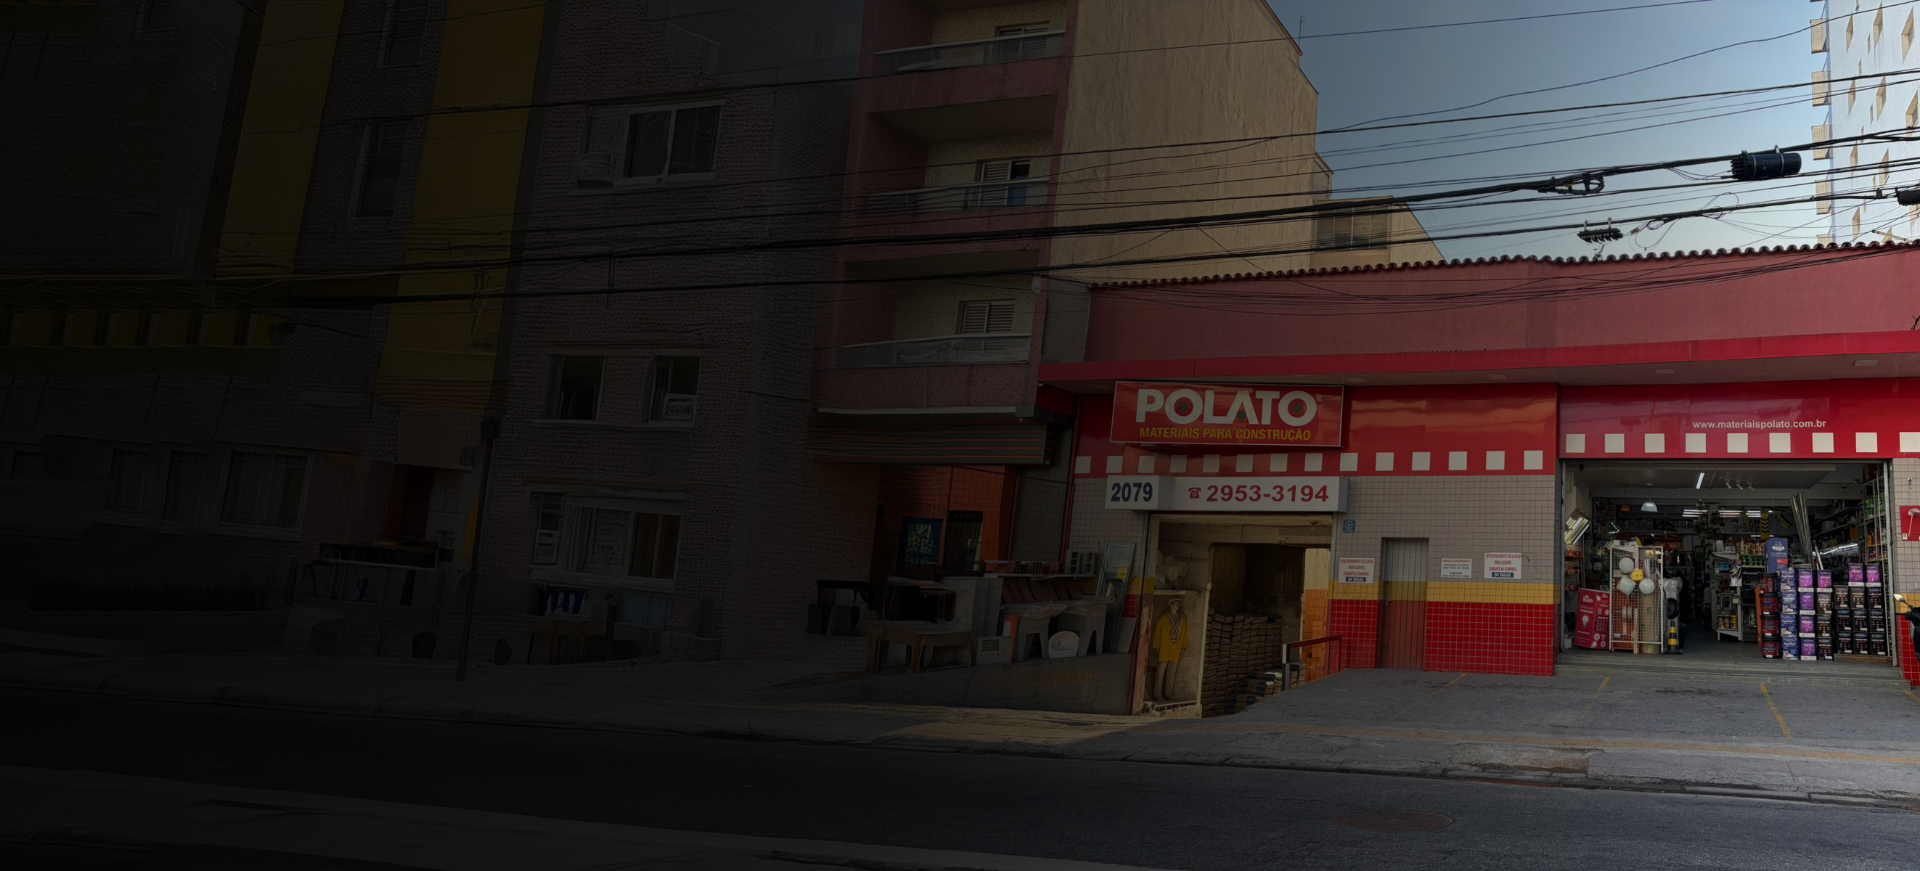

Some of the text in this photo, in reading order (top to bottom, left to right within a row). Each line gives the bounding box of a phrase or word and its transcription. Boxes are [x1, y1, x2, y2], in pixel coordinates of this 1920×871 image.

[1135, 388, 1317, 427] POLATO
[1139, 427, 1311, 441] MATERIAIS PARA CONSTRUÇÃO
[1692, 419, 1827, 430] www.materiaispolato.com.br
[1110, 482, 1153, 503] 2079
[1206, 484, 1329, 503] 2953-3194
